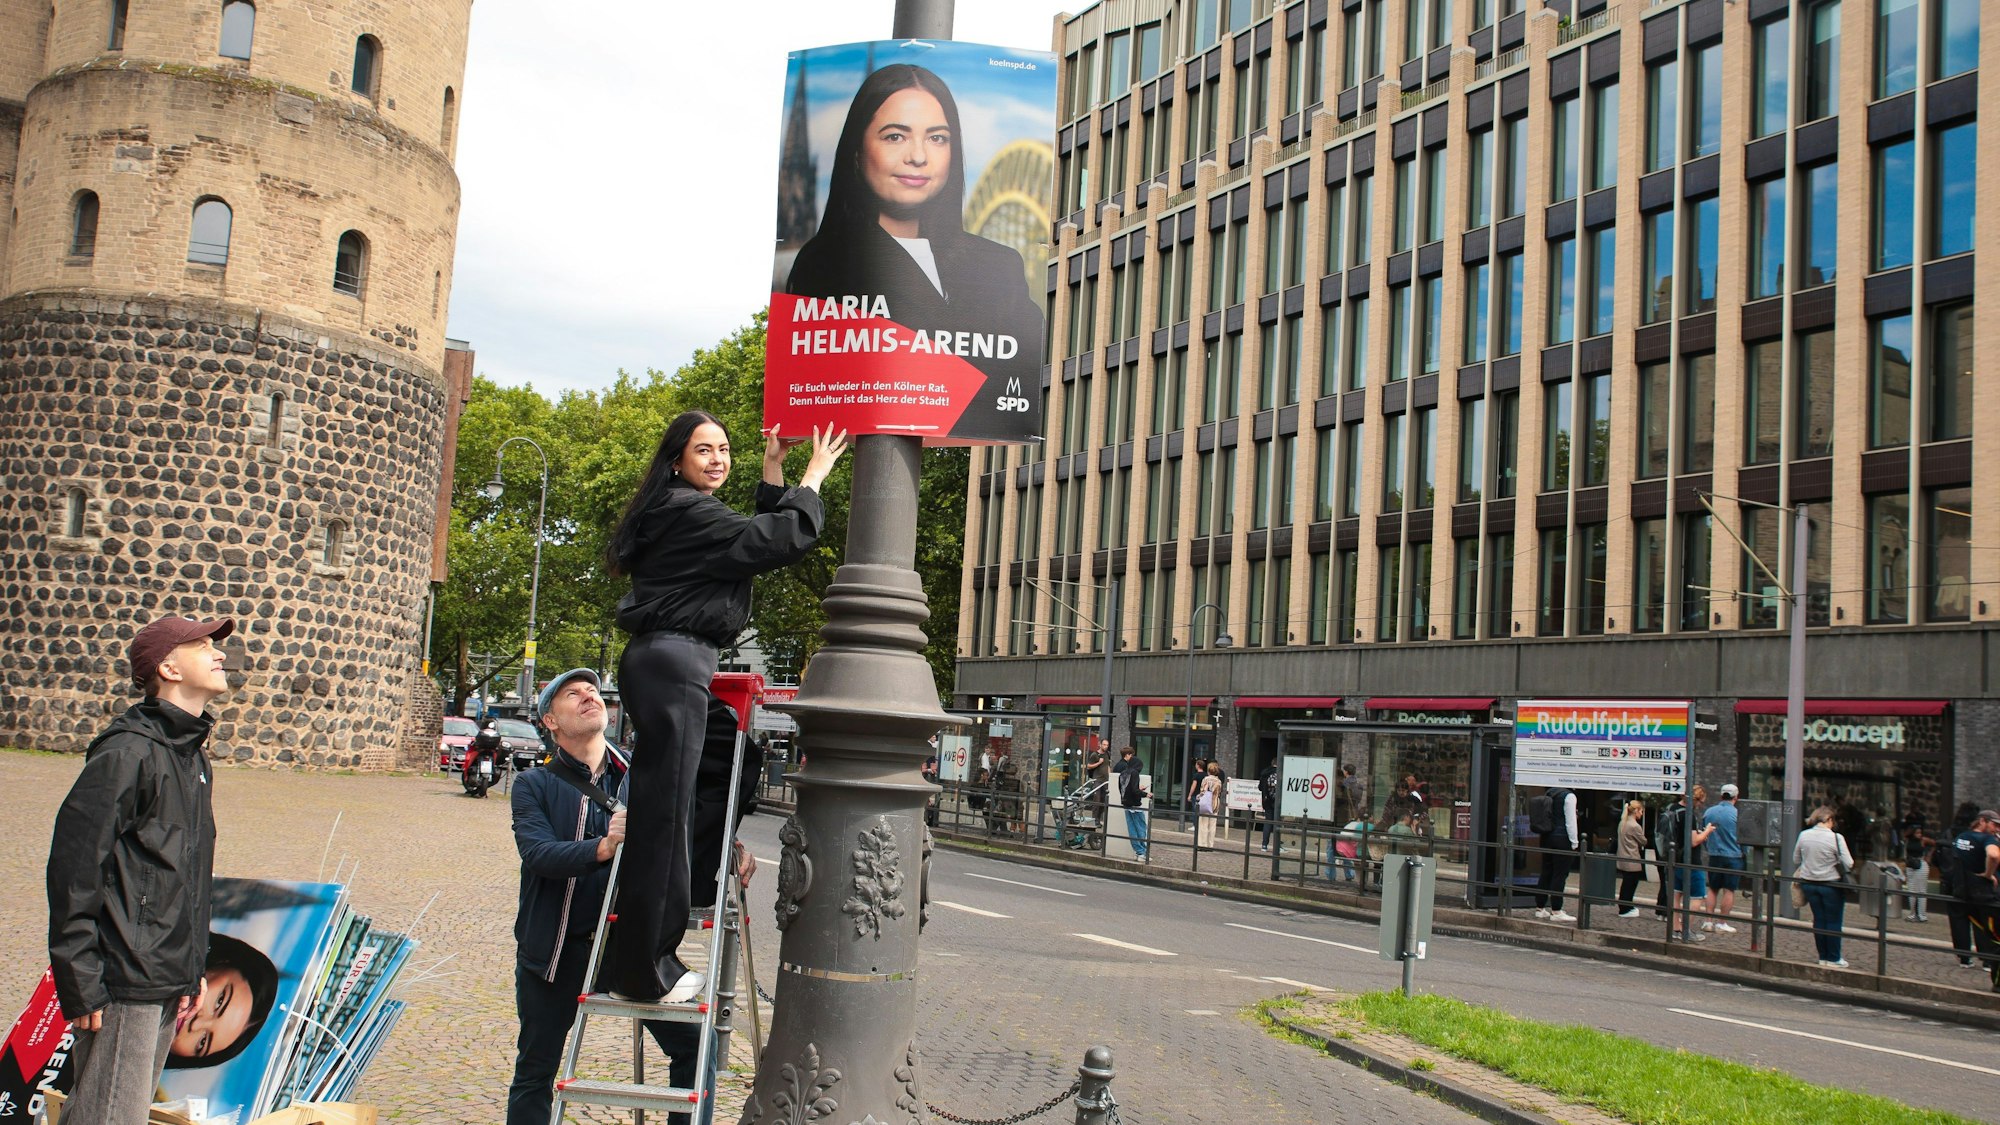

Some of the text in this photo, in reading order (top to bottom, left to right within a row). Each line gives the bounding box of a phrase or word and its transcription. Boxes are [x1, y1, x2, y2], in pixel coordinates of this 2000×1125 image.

[989, 58, 1036, 71] koelnspd.de
[792, 294, 891, 322] MARIA
[791, 327, 1018, 360] HELMIS-AREND
[789, 380, 948, 393] Für Euch wieder in den Kölner Rat.
[789, 394, 949, 407] Denn Kultur ist das Herz der Stadt!
[996, 396, 1030, 413] SPD
[1537, 710, 1663, 741] Rudolfplatz
[943, 750, 956, 762] KVB
[1598, 748, 1610, 757] 146
[1287, 777, 1310, 793] KVB
[349, 953, 371, 977] FÜR
